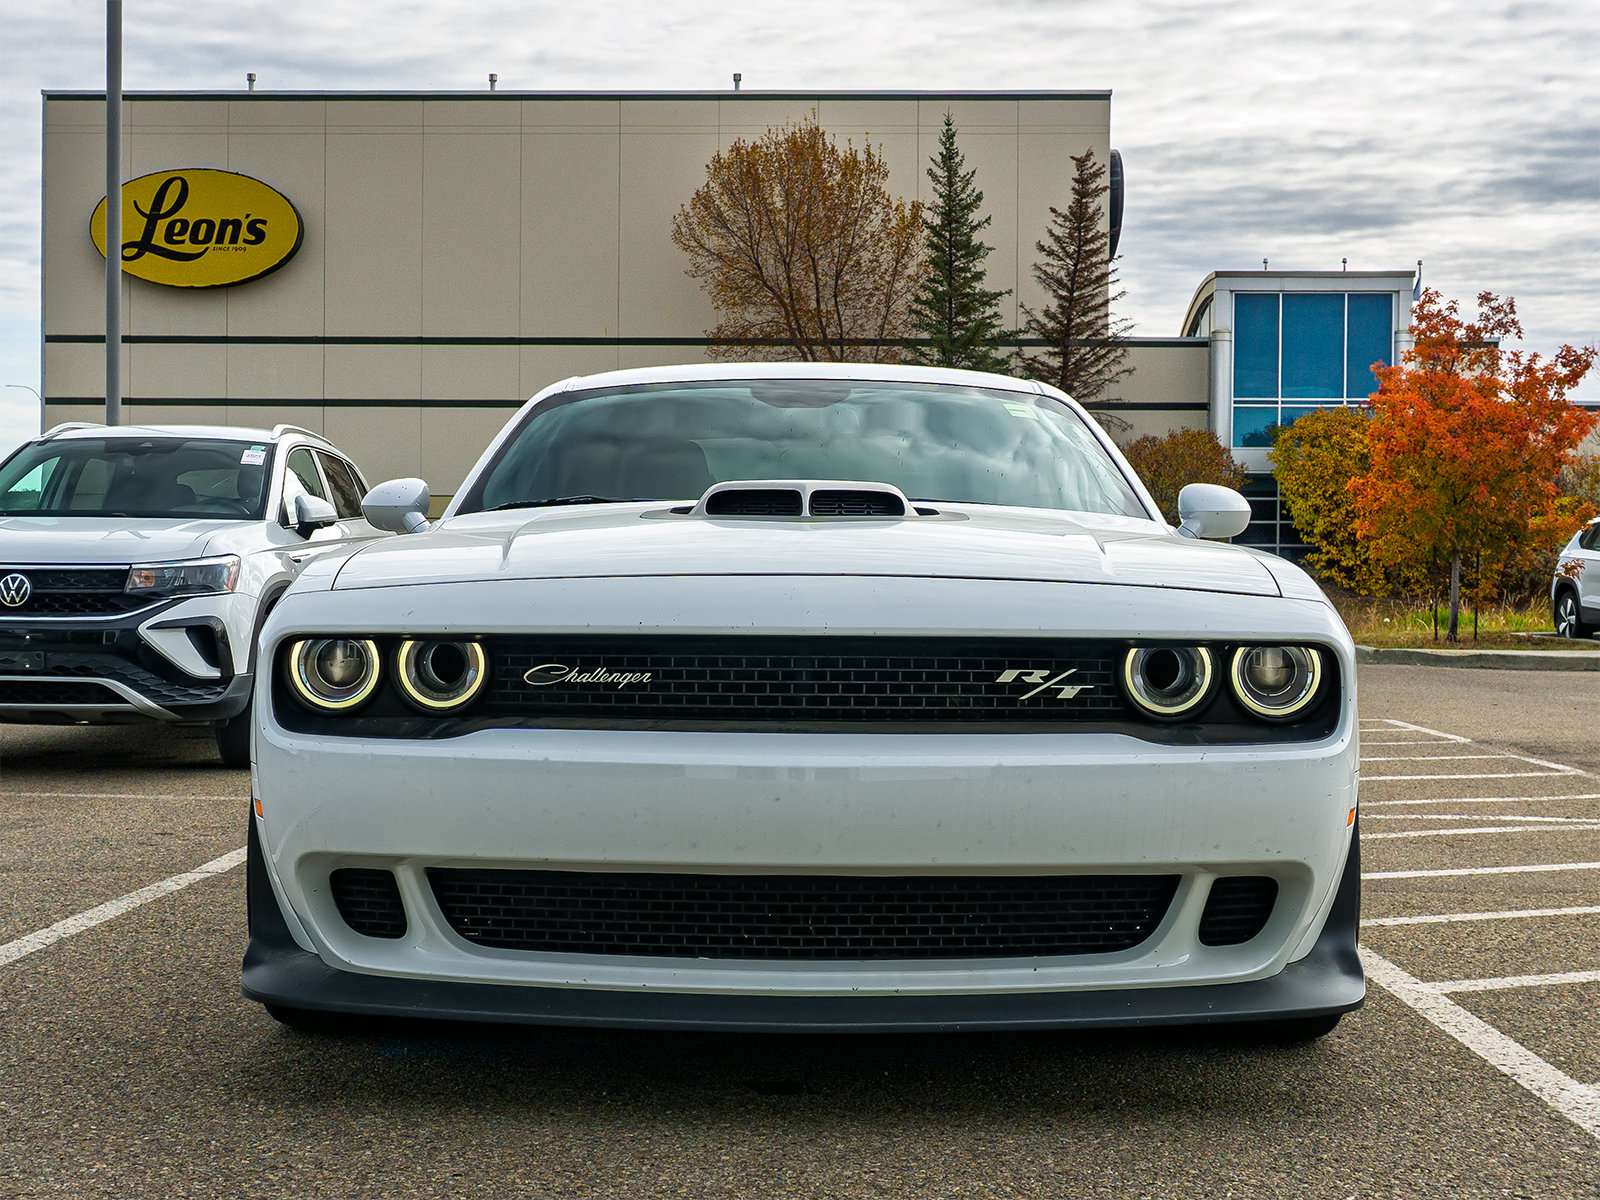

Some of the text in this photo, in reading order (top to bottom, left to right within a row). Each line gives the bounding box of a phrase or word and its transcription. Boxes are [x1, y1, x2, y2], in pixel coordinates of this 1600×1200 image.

[121, 176, 268, 261] Leon's
[523, 664, 652, 689] Challenger
[995, 668, 1095, 700] R/T
